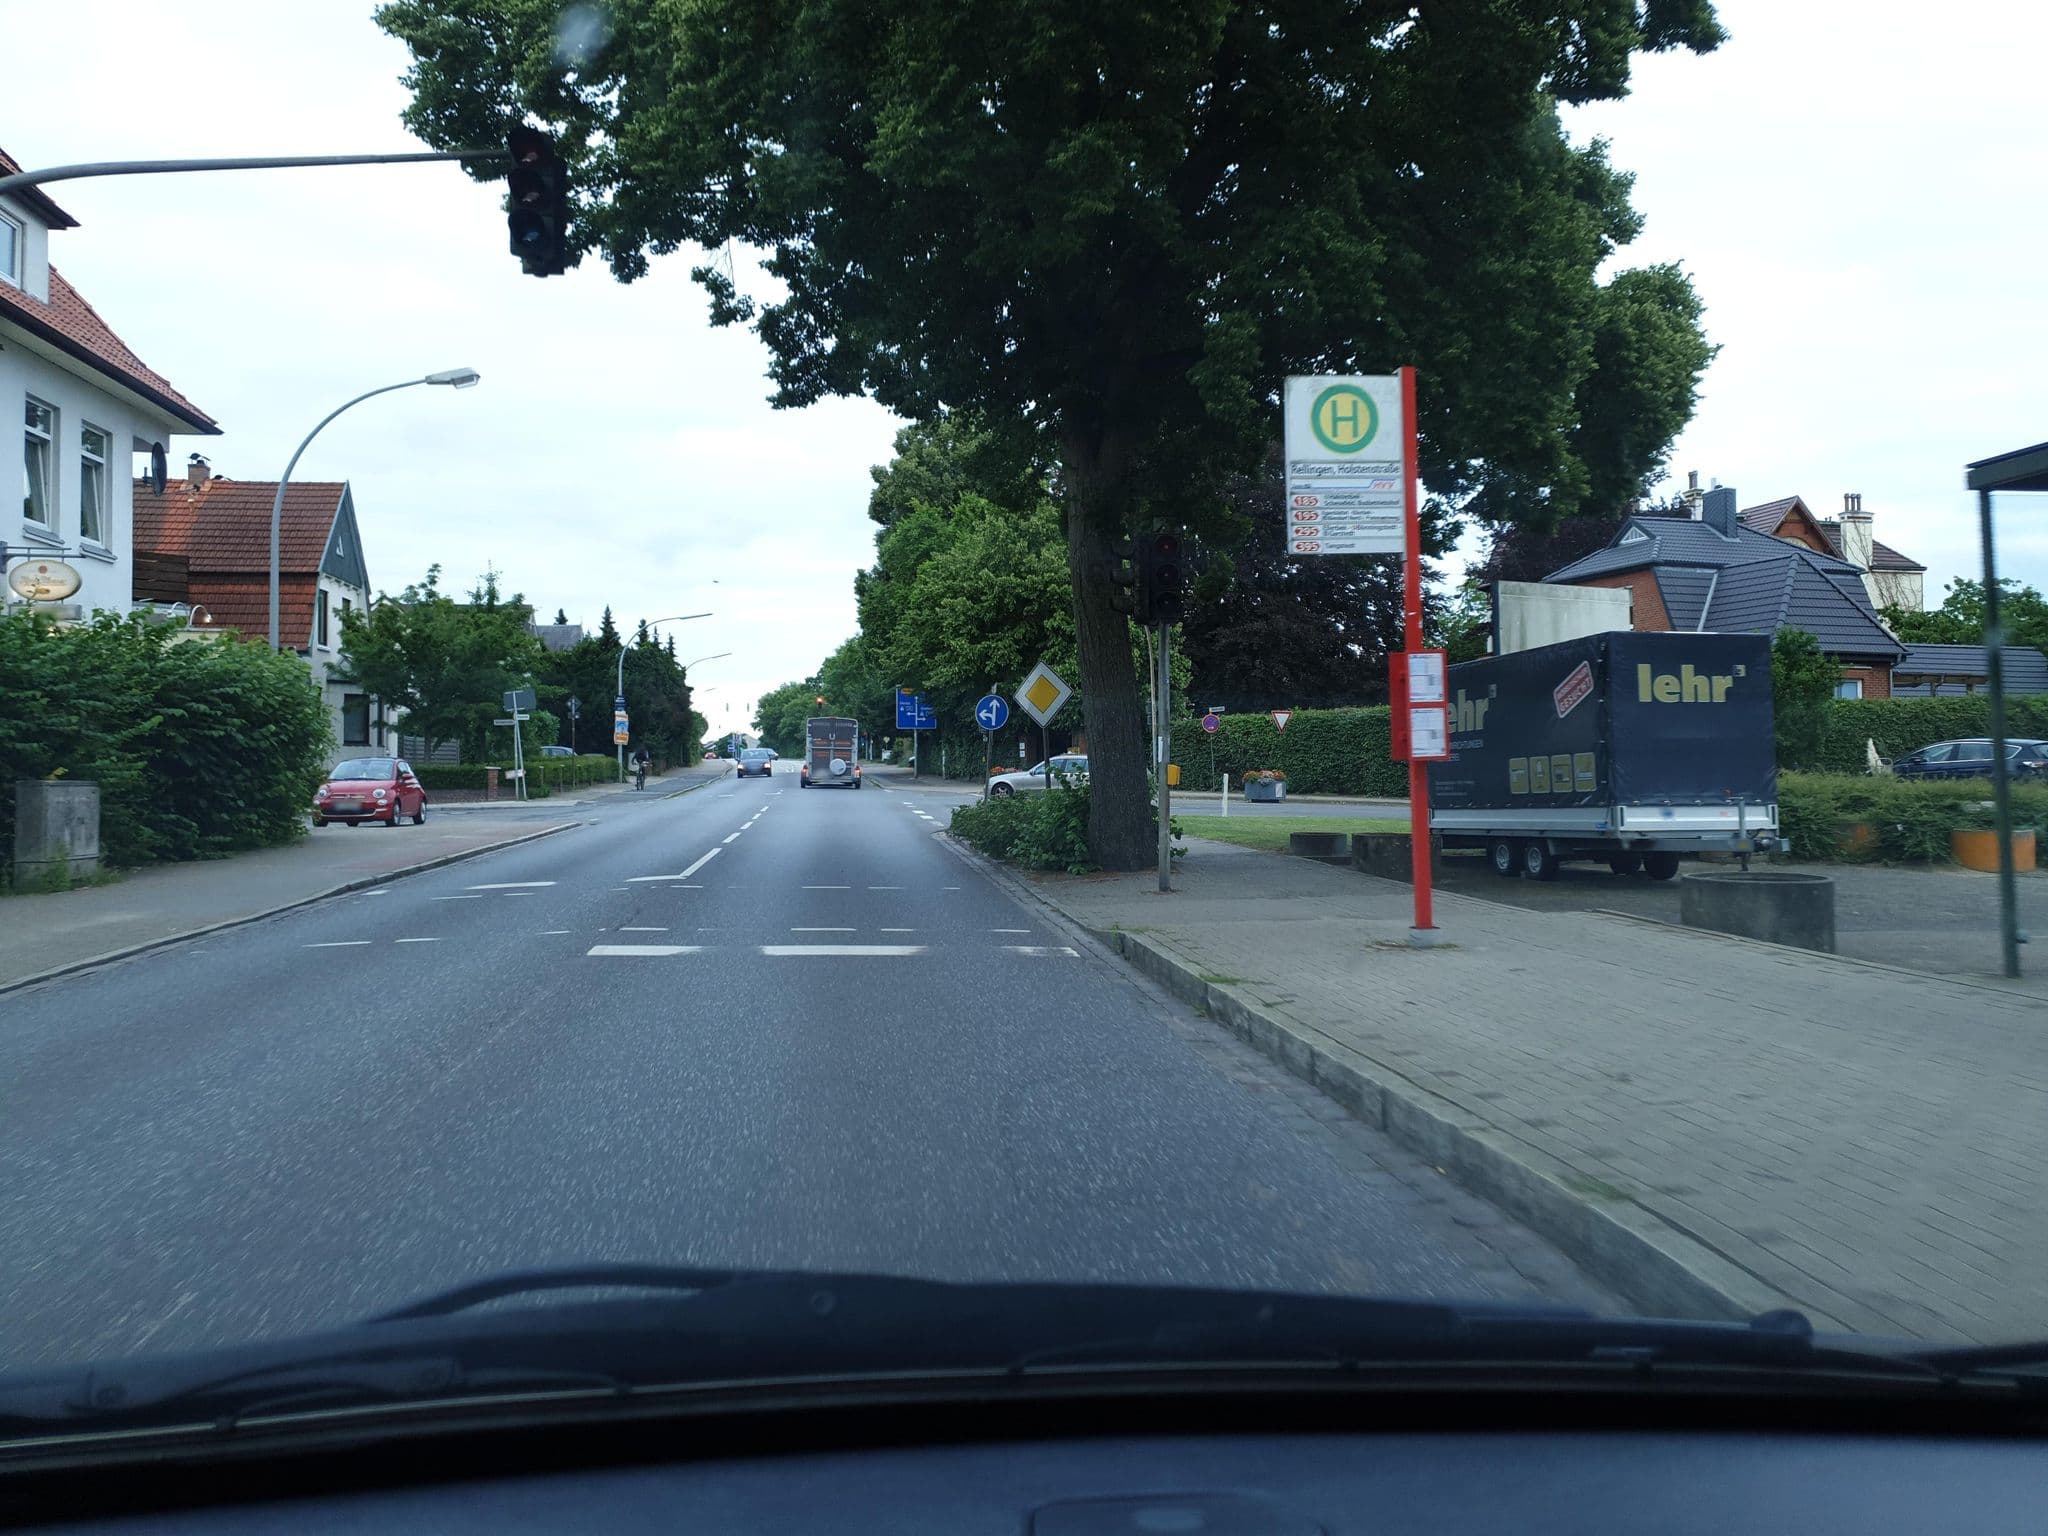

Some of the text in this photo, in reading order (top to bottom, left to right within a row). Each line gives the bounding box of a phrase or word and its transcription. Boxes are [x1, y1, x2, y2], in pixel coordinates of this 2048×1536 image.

[1331, 400, 1358, 438] H
[1637, 664, 1733, 702] lehr
[1448, 689, 1489, 733] ehr
